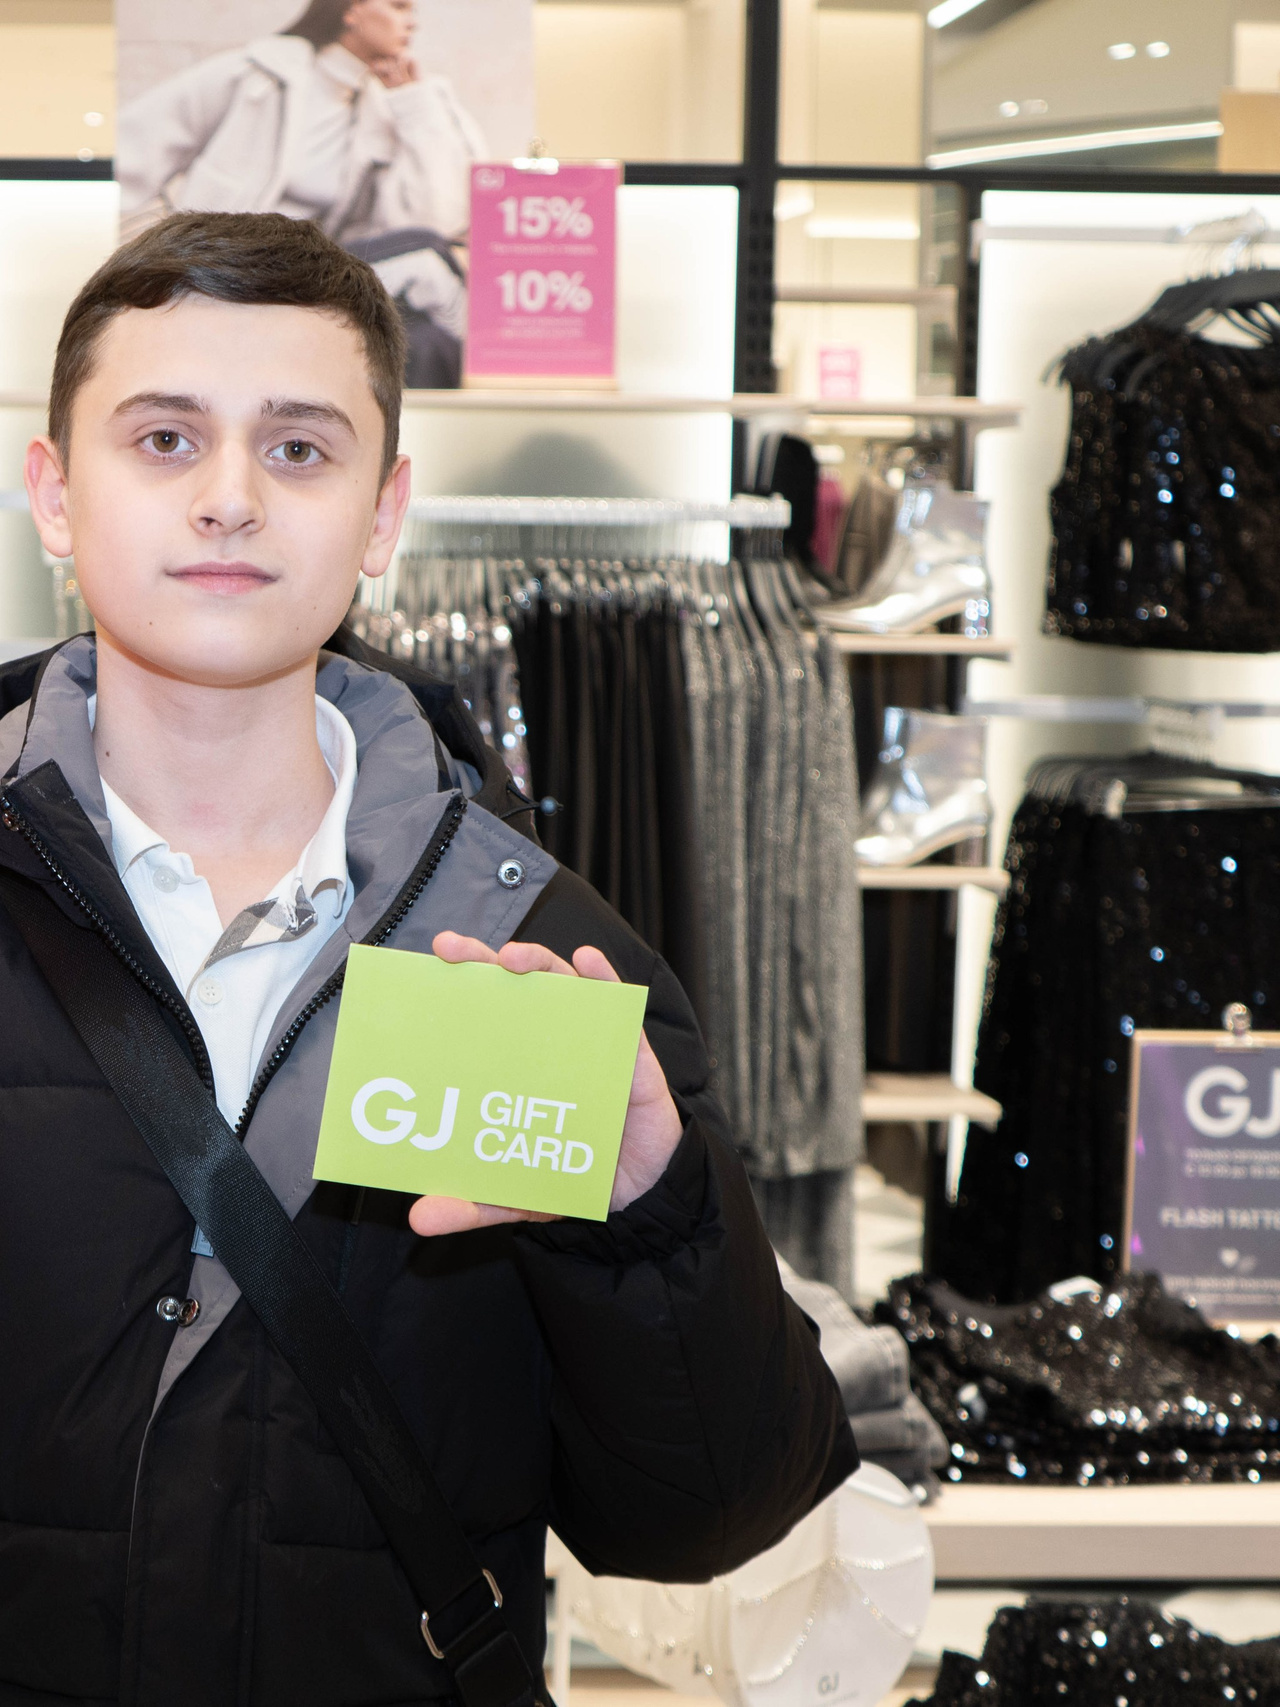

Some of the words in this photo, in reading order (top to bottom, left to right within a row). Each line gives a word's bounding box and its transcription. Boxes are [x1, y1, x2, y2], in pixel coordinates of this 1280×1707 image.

[498, 196, 594, 239] 15%
[496, 269, 594, 313] 10%
[350, 1077, 460, 1151] GJ
[480, 1091, 577, 1134] GIFT
[1184, 1065, 1280, 1139] GJ
[473, 1128, 594, 1174] CARD
